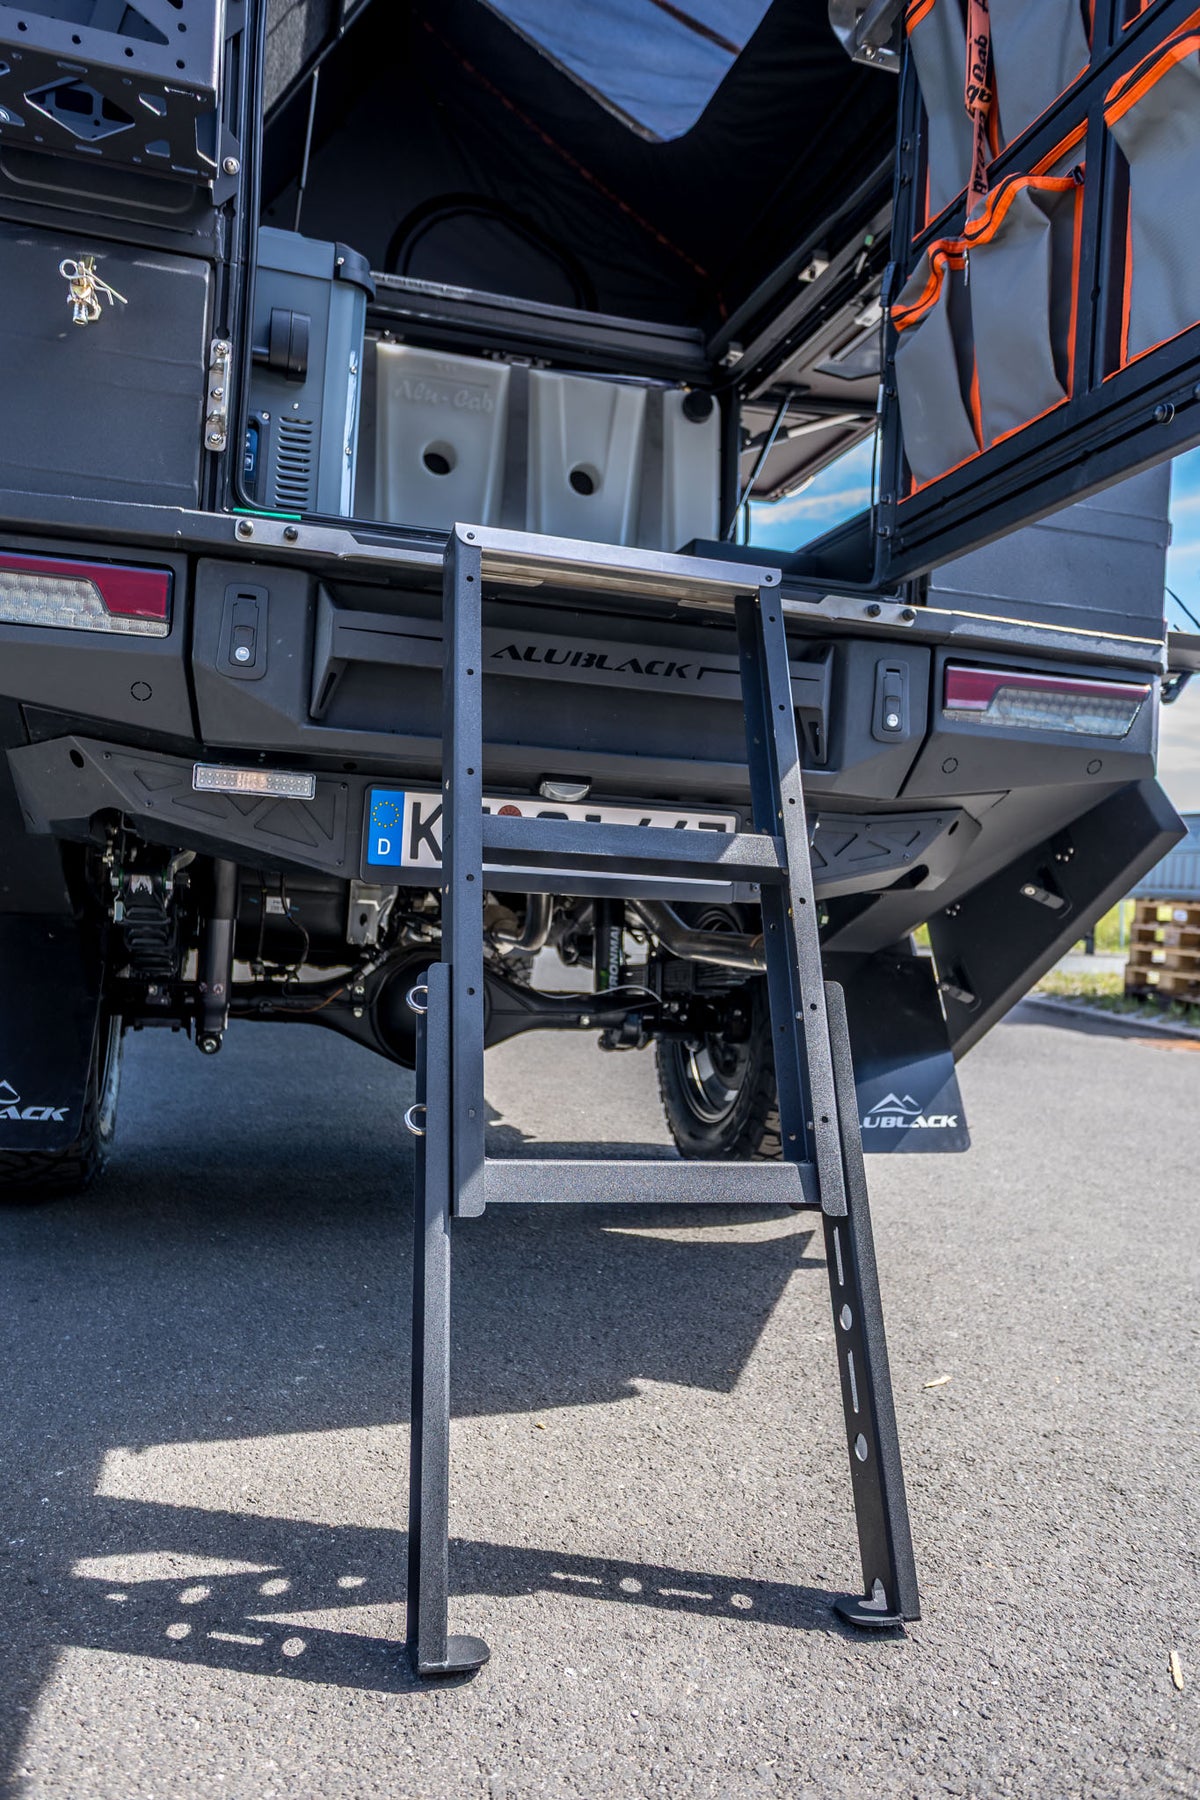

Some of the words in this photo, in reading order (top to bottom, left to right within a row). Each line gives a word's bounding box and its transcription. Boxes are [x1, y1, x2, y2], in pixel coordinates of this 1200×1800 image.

[489, 644, 694, 679] ALUBLACK
[377, 838, 391, 855] D
[859, 1114, 958, 1129] UBLACK
